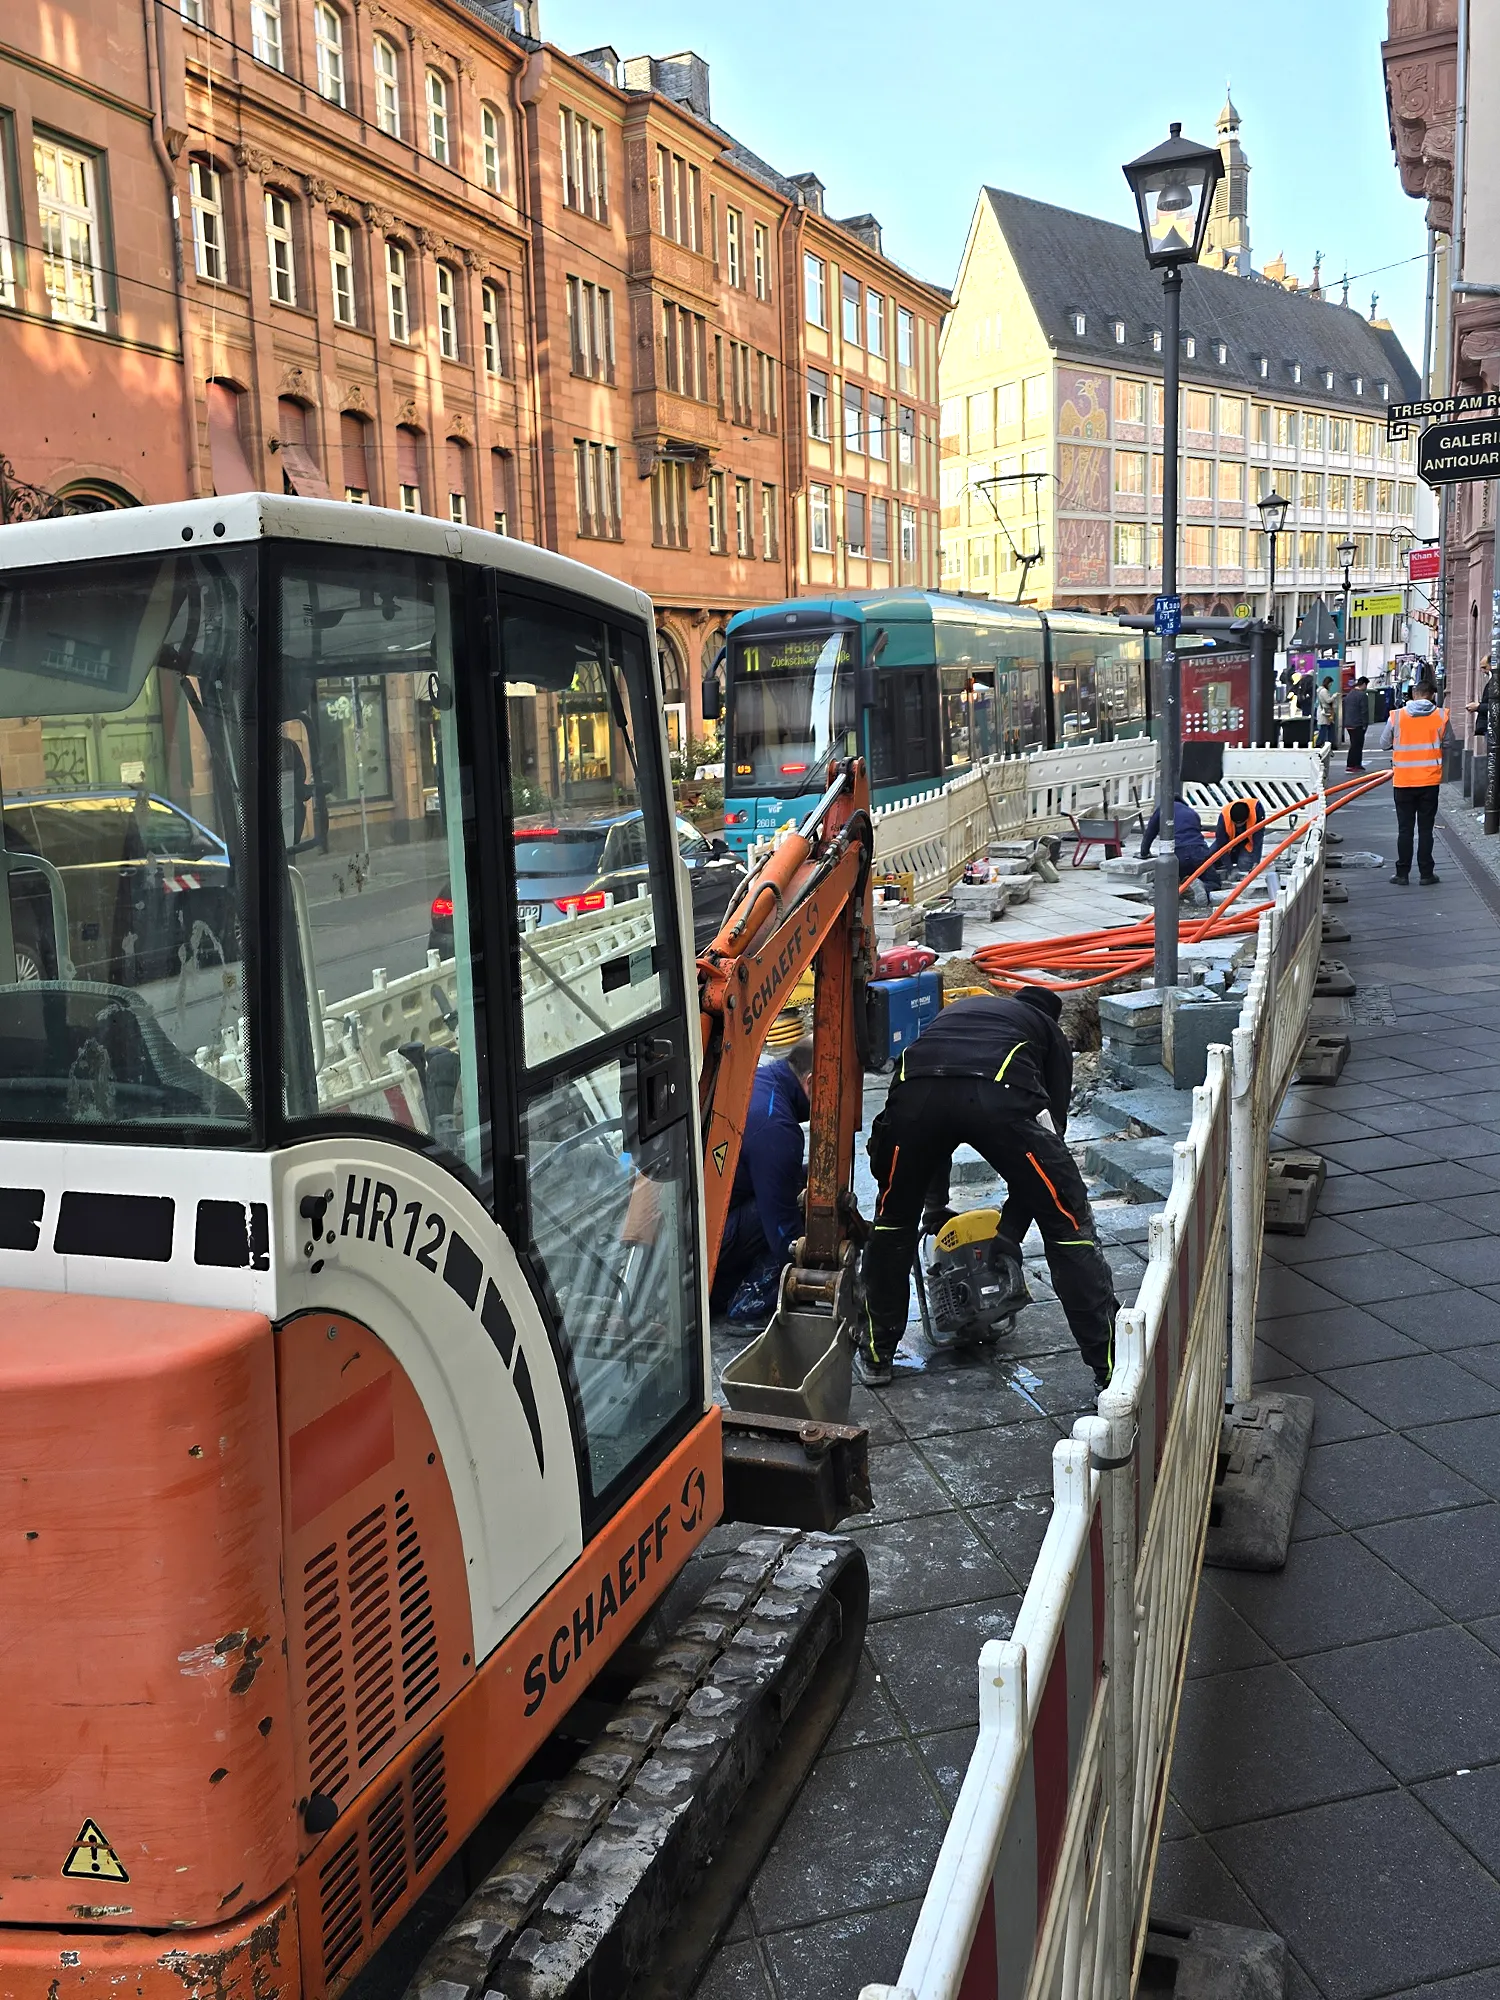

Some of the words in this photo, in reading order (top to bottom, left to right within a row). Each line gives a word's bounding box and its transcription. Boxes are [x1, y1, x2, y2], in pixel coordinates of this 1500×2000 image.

[1392, 400, 1455, 418] TRESOR
[1459, 397, 1482, 409] AM
[1487, 394, 1500, 406] R
[1440, 432, 1500, 449] GALERI
[1424, 452, 1499, 471] ANTIQUAR
[1411, 553, 1432, 561] Khan
[1354, 600, 1368, 611] H.
[743, 646, 760, 672] 11
[1189, 657, 1214, 668] FIVE
[1216, 653, 1250, 665] GUYS
[743, 924, 802, 1036] SCHAEFF
[523, 1503, 671, 1718] SCHAEFF
